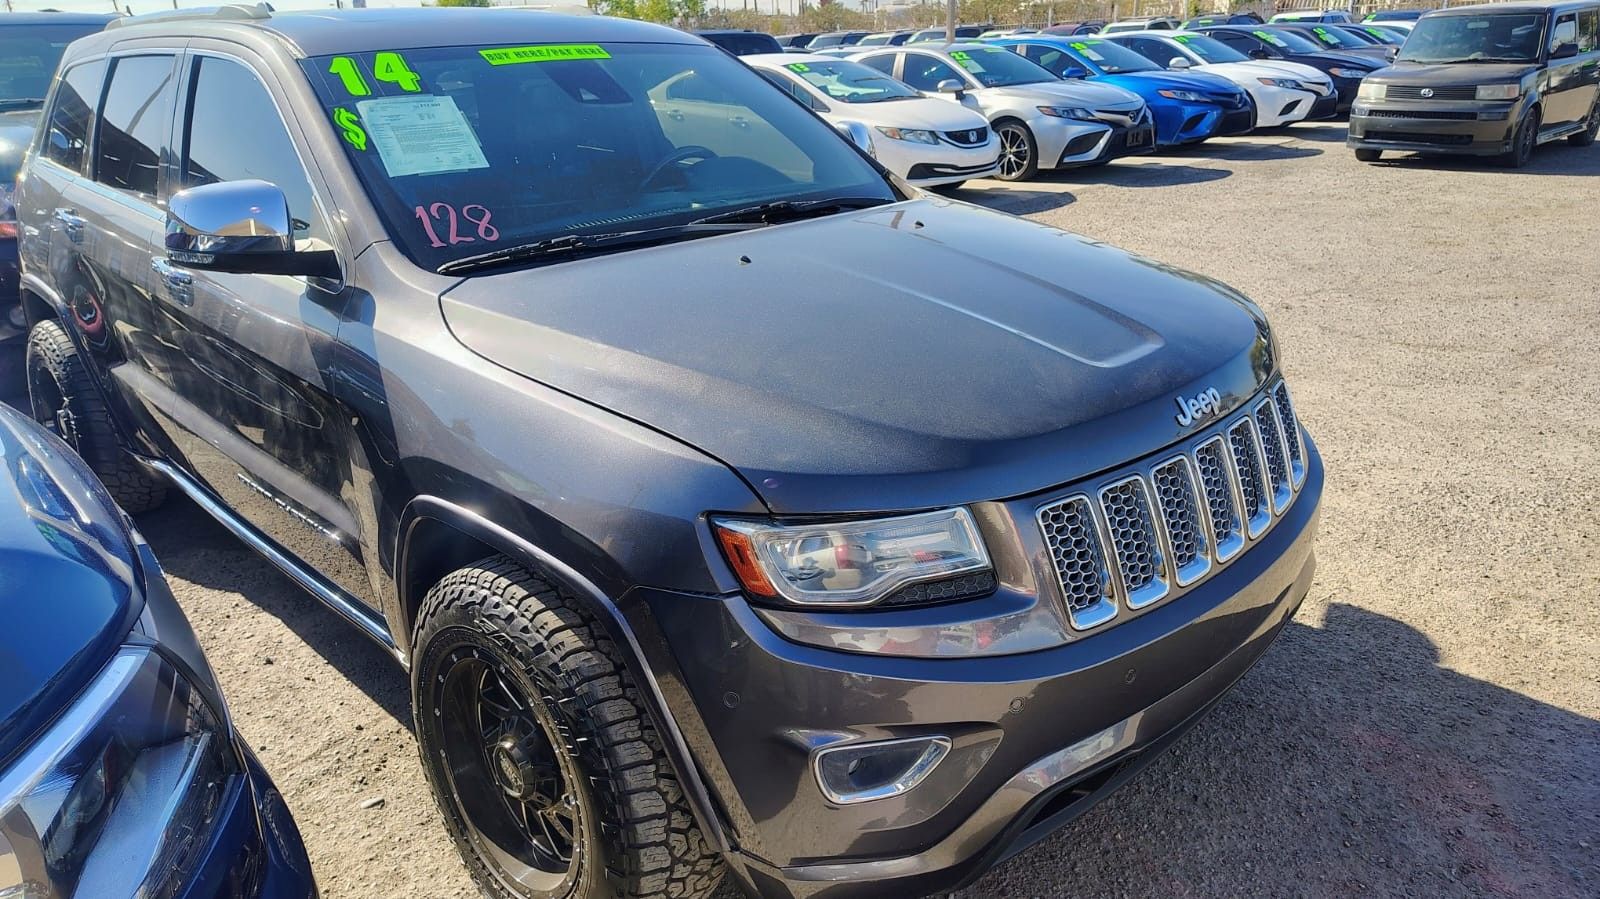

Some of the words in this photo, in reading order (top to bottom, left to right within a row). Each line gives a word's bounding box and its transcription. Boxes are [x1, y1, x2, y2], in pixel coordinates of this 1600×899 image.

[328, 51, 421, 97] 14
[485, 52, 511, 60] BUY
[575, 47, 607, 56] HERE
[950, 51, 971, 61] 22
[333, 107, 366, 151] $
[415, 202, 500, 248] 128
[1175, 387, 1221, 426] Jeep
